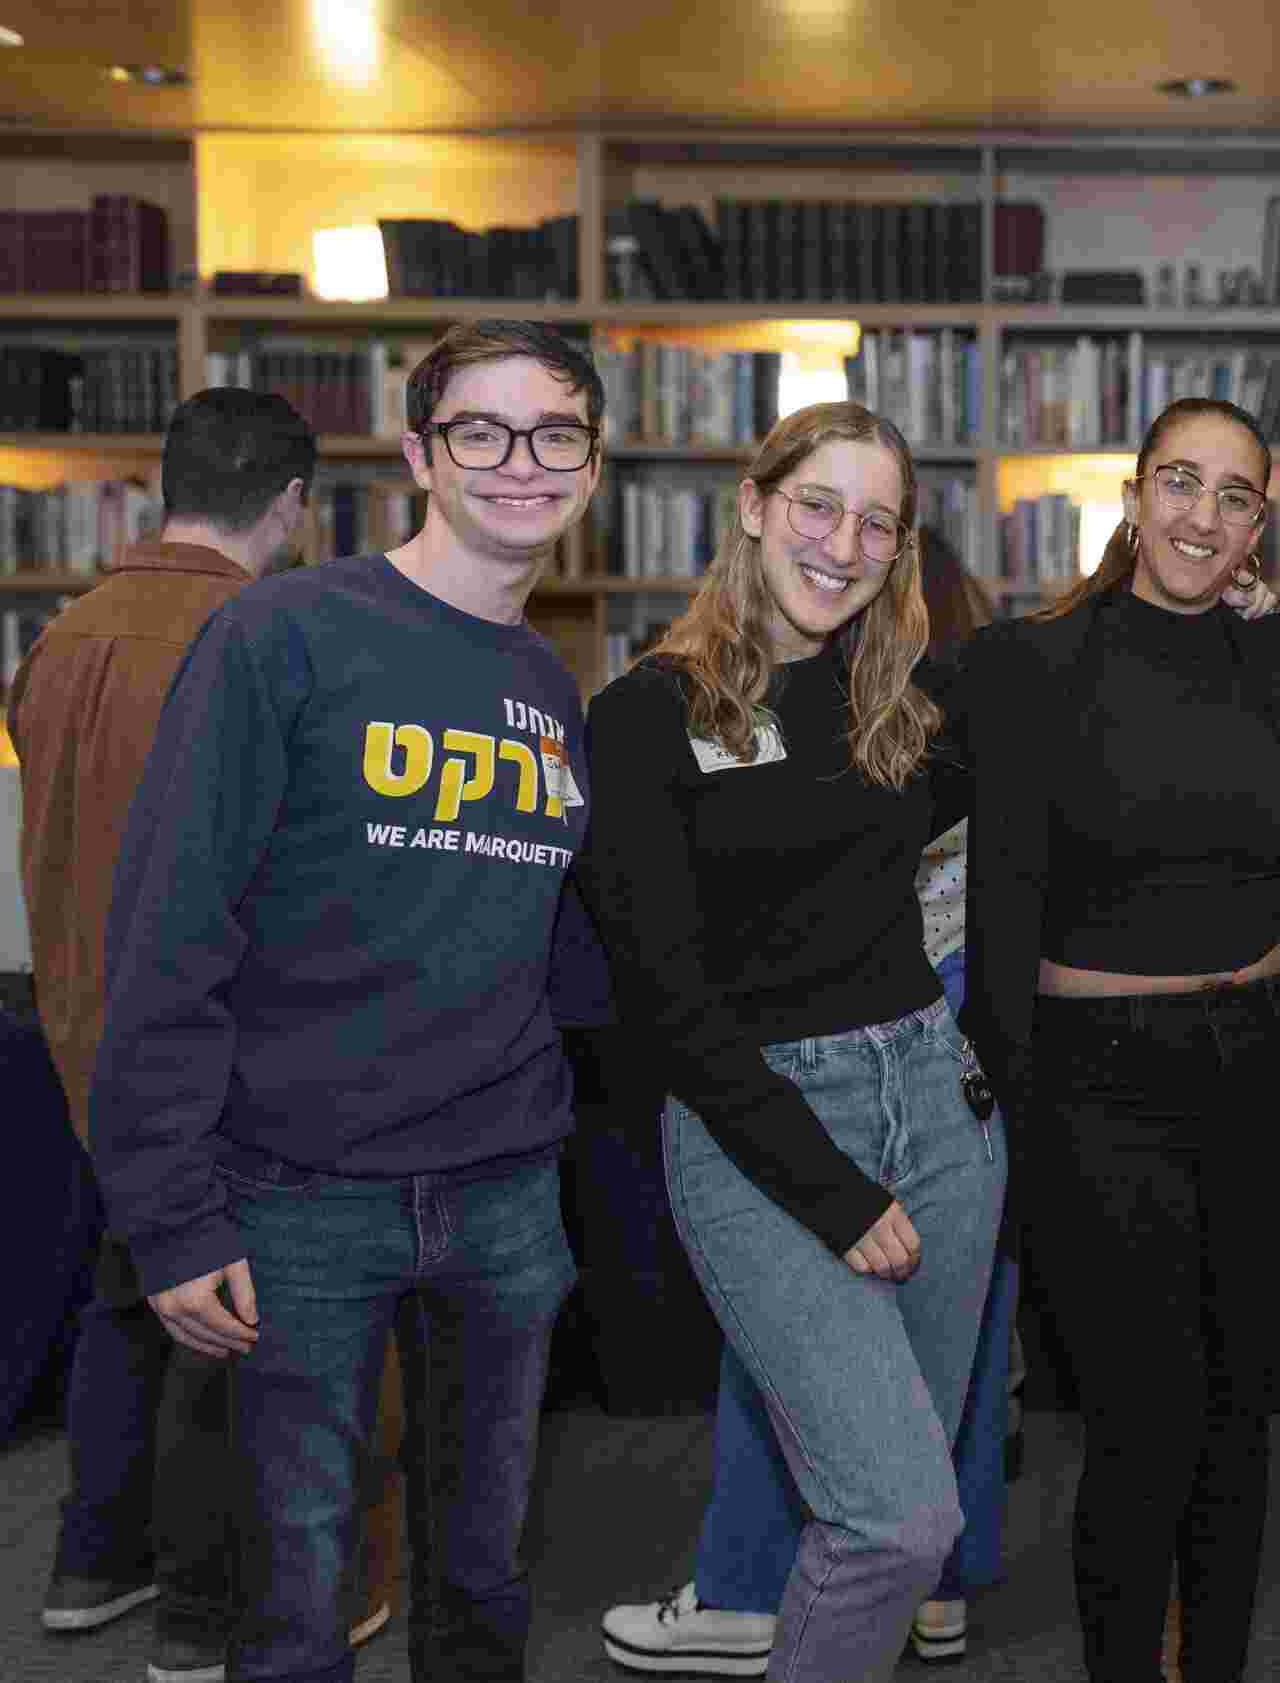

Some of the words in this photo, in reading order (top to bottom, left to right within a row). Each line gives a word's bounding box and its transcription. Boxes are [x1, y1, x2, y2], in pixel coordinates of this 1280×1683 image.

[363, 721, 567, 824] רקט
[367, 823, 407, 847] WE
[410, 829, 461, 850] ARE
